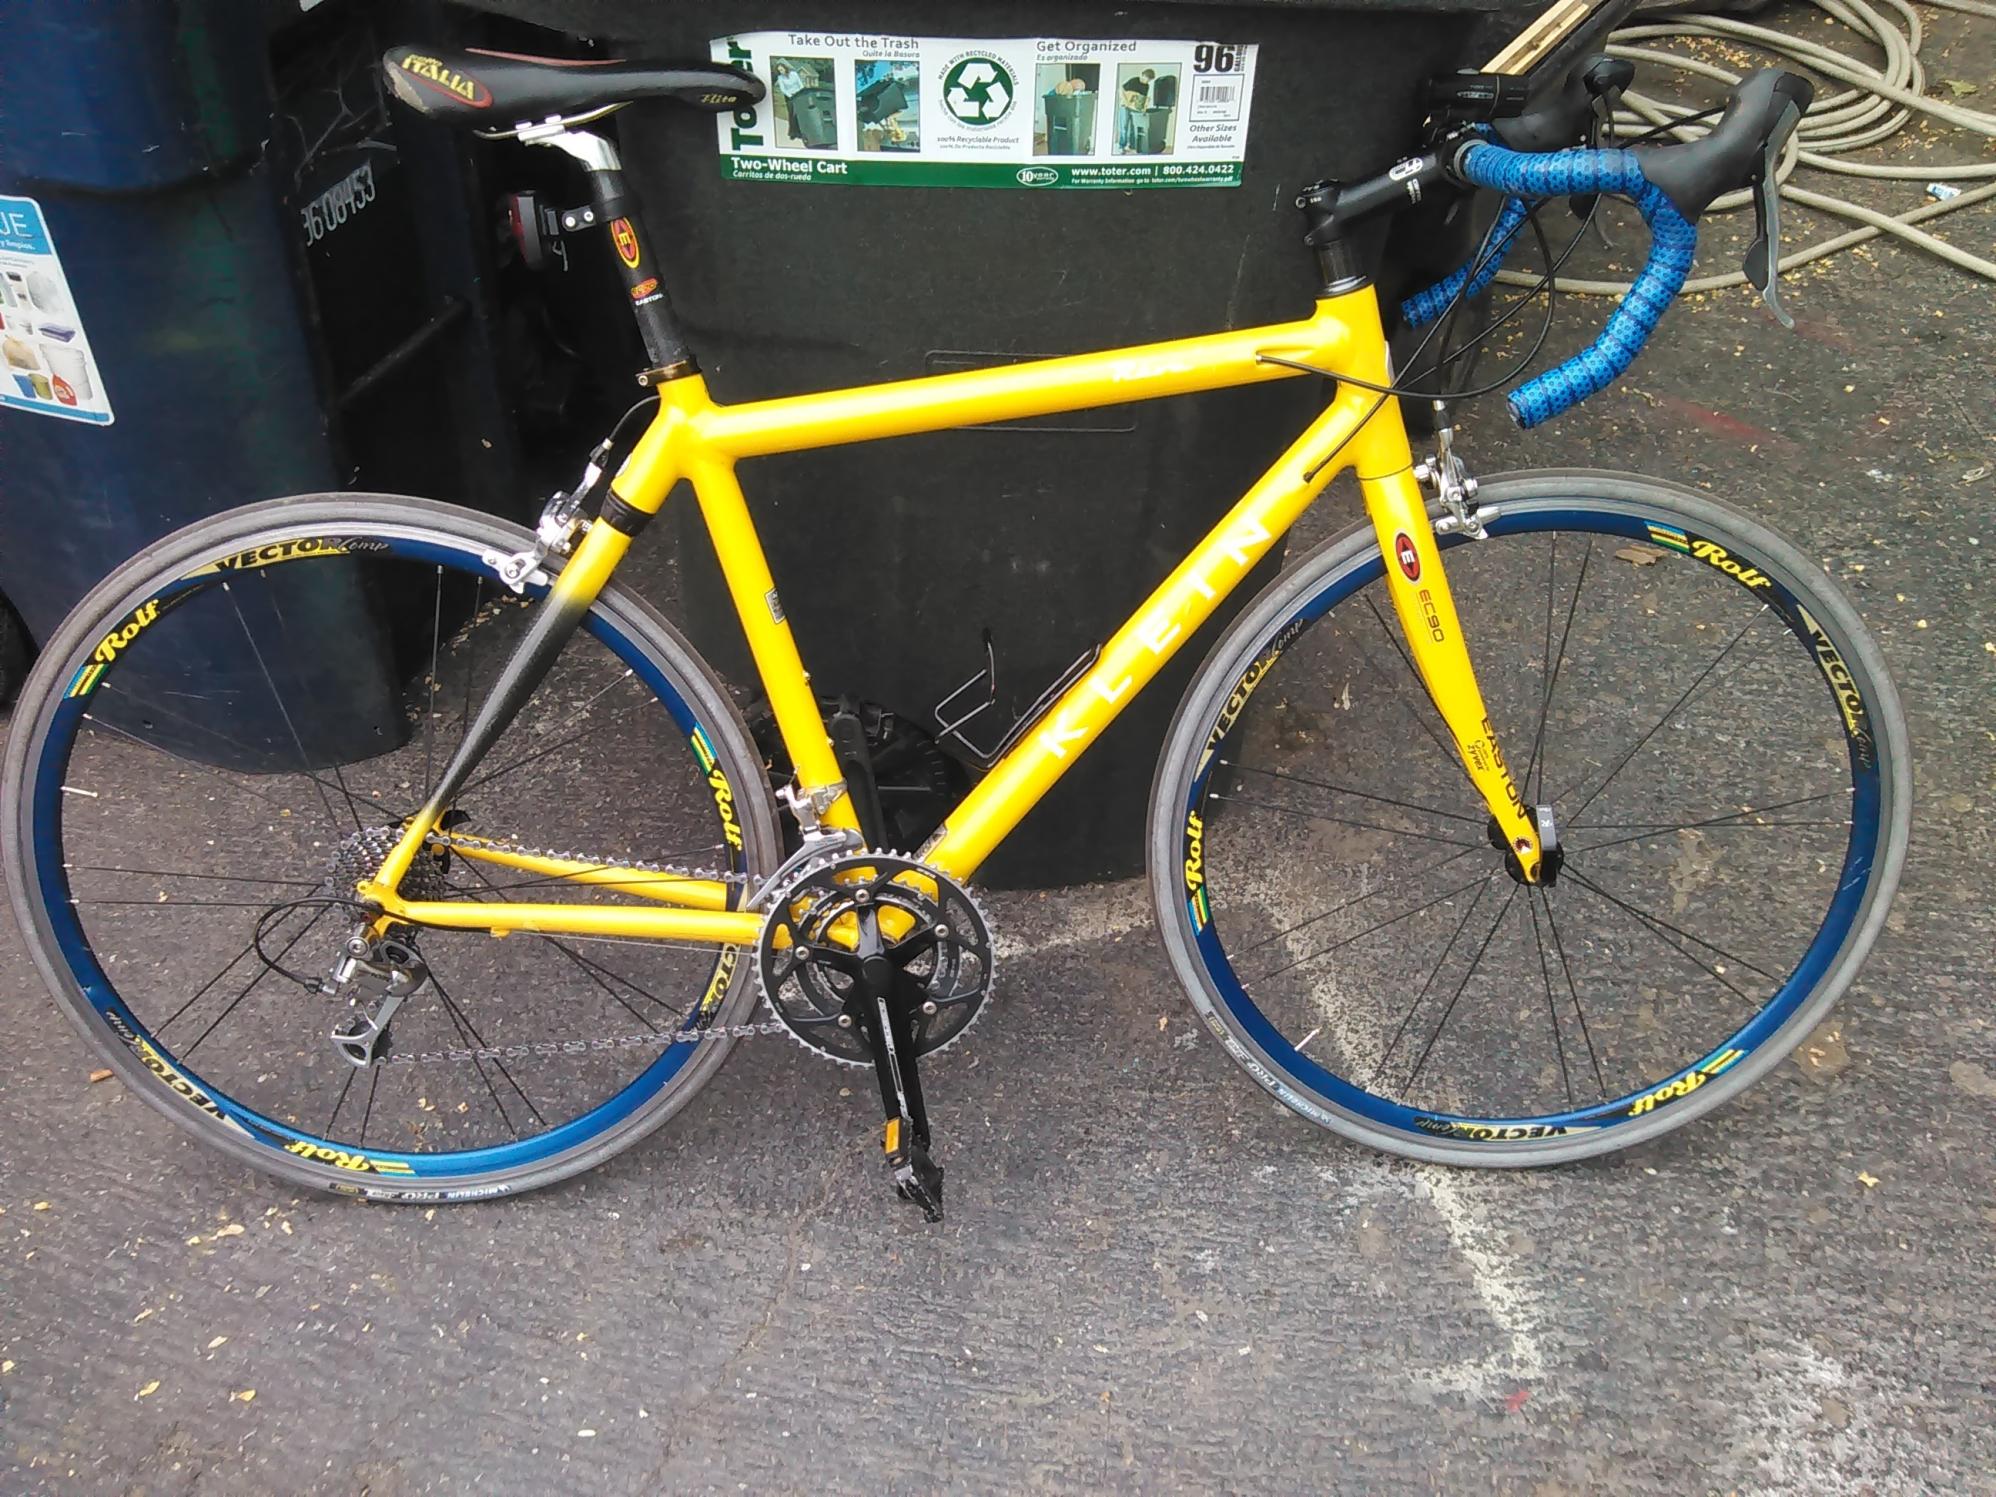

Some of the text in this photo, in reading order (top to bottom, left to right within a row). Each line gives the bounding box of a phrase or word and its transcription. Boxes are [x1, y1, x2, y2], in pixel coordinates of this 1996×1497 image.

[788, 33, 919, 49] Take Out the Trash
[893, 50, 920, 58] Basura
[1036, 41, 1137, 56] Get Organized
[938, 50, 1020, 86] MADE WITH RECYCLED MATERIALS
[1047, 53, 1088, 63] organizado
[1193, 44, 1236, 73] 96
[402, 57, 475, 101] ITALIA
[992, 136, 1020, 144] Product
[1189, 123, 1237, 133] Other Sizes
[1192, 134, 1232, 143] Available
[731, 157, 848, 175] Two-Wheel Cart
[733, 170, 763, 180] Carritos
[764, 171, 774, 180] de
[1022, 171, 1033, 182] 10
[1071, 164, 1235, 176] www.toter.com 800.424.0422
[214, 537, 342, 571] VECTOR
[1690, 540, 1772, 589] Rolf
[1419, 588, 1445, 643] EC90
[94, 599, 160, 663] Rolf
[1038, 516, 1272, 759] KLEIN
[1481, 717, 1528, 820] EASTON
[708, 768, 742, 852] Rolf
[1184, 809, 1205, 892] Rolf
[1628, 1070, 1706, 1117] Rolf
[284, 1140, 371, 1172] Rolf
[448, 1186, 499, 1199] MICHELIN
